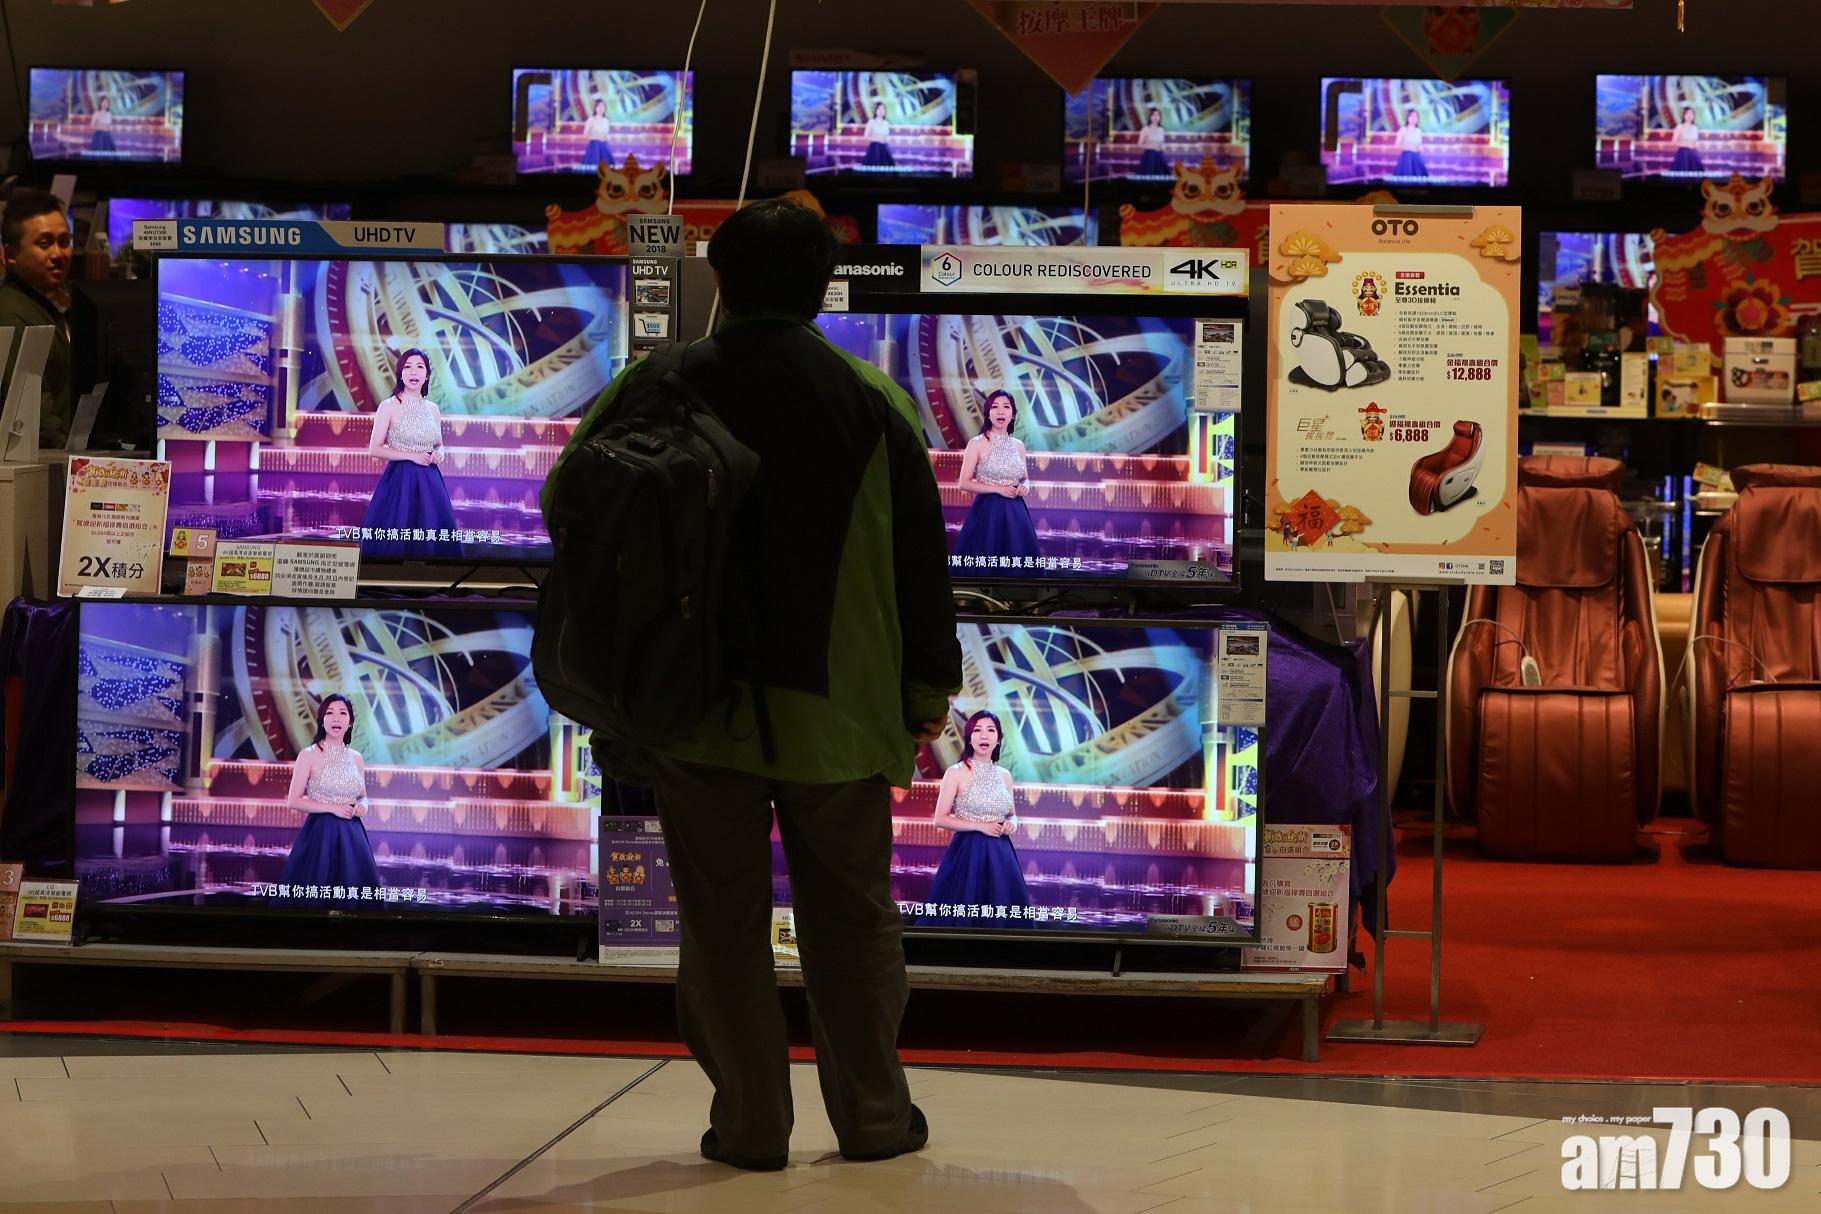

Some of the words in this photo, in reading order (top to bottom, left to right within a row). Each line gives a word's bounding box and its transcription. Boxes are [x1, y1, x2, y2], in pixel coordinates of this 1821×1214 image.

[183, 225, 301, 246] SAMSUNG
[629, 225, 680, 244] NEW
[1371, 219, 1419, 236] OTO
[646, 245, 666, 253] 2018
[632, 266, 653, 275] UHD
[655, 266, 669, 276] TV
[832, 261, 905, 277] anasonic
[942, 256, 951, 271] 6
[973, 263, 1033, 277] COLOUR
[1038, 263, 1152, 279] REDISCOVERED
[1170, 259, 1220, 280] 4K
[1220, 260, 1237, 269] HDR
[1394, 281, 1461, 296] Essentia
[1446, 367, 1492, 382] $12,888
[1389, 429, 1429, 443] $6,888
[1297, 504, 1325, 531] 福
[197, 534, 209, 550] 5
[335, 527, 502, 544] TVB幫你搞活動真是相當容易
[77, 555, 144, 579] 2X積分
[2, 869, 15, 885] 3
[250, 884, 428, 902] TVB幫你搞活動真是相當容易
[898, 903, 1078, 921] TVB幫你搞活動真是相當容易
[630, 919, 642, 928] 2X
